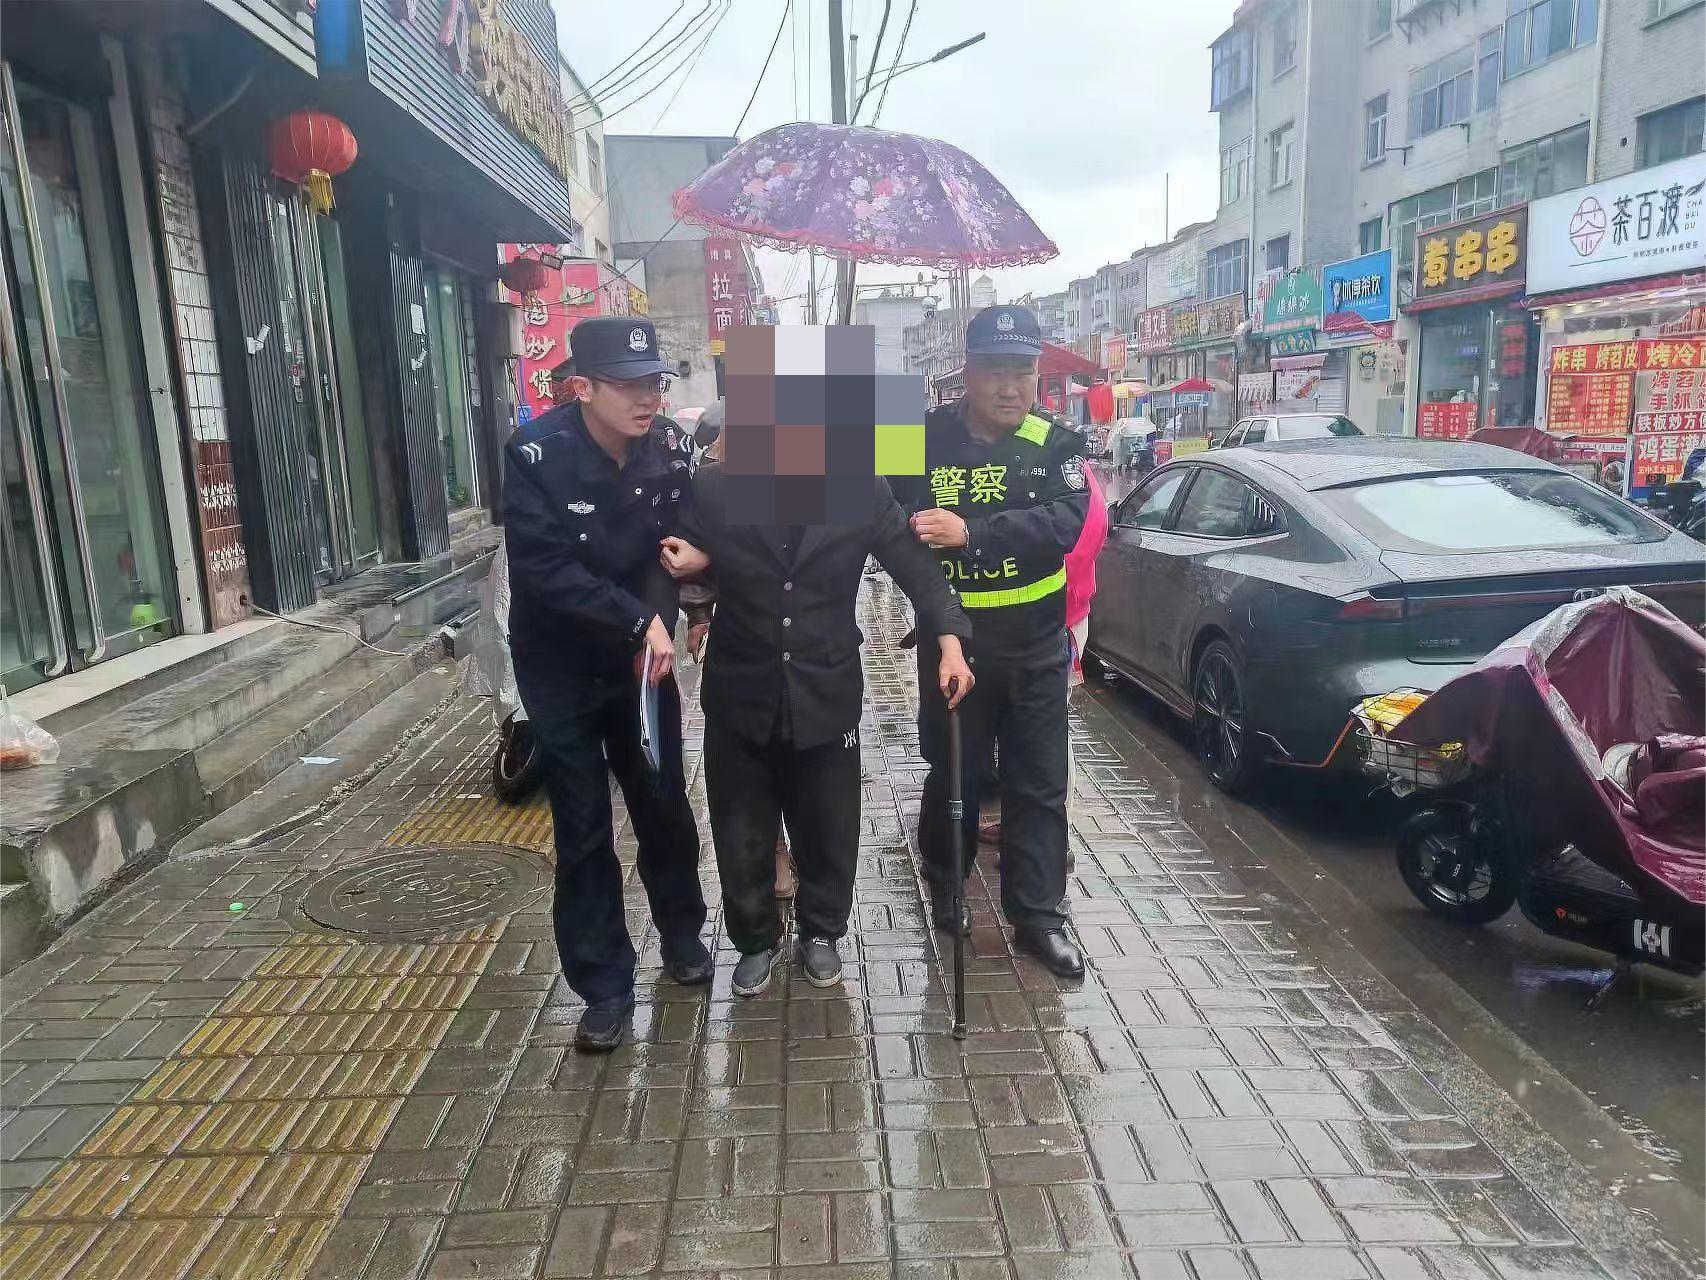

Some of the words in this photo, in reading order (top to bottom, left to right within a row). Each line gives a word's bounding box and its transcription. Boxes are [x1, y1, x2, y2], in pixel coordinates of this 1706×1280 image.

[1424, 221, 1518, 288] 煮串串
[712, 271, 735, 332] 拉面
[930, 463, 1008, 508] 警察
[942, 556, 1018, 581] OLICE
